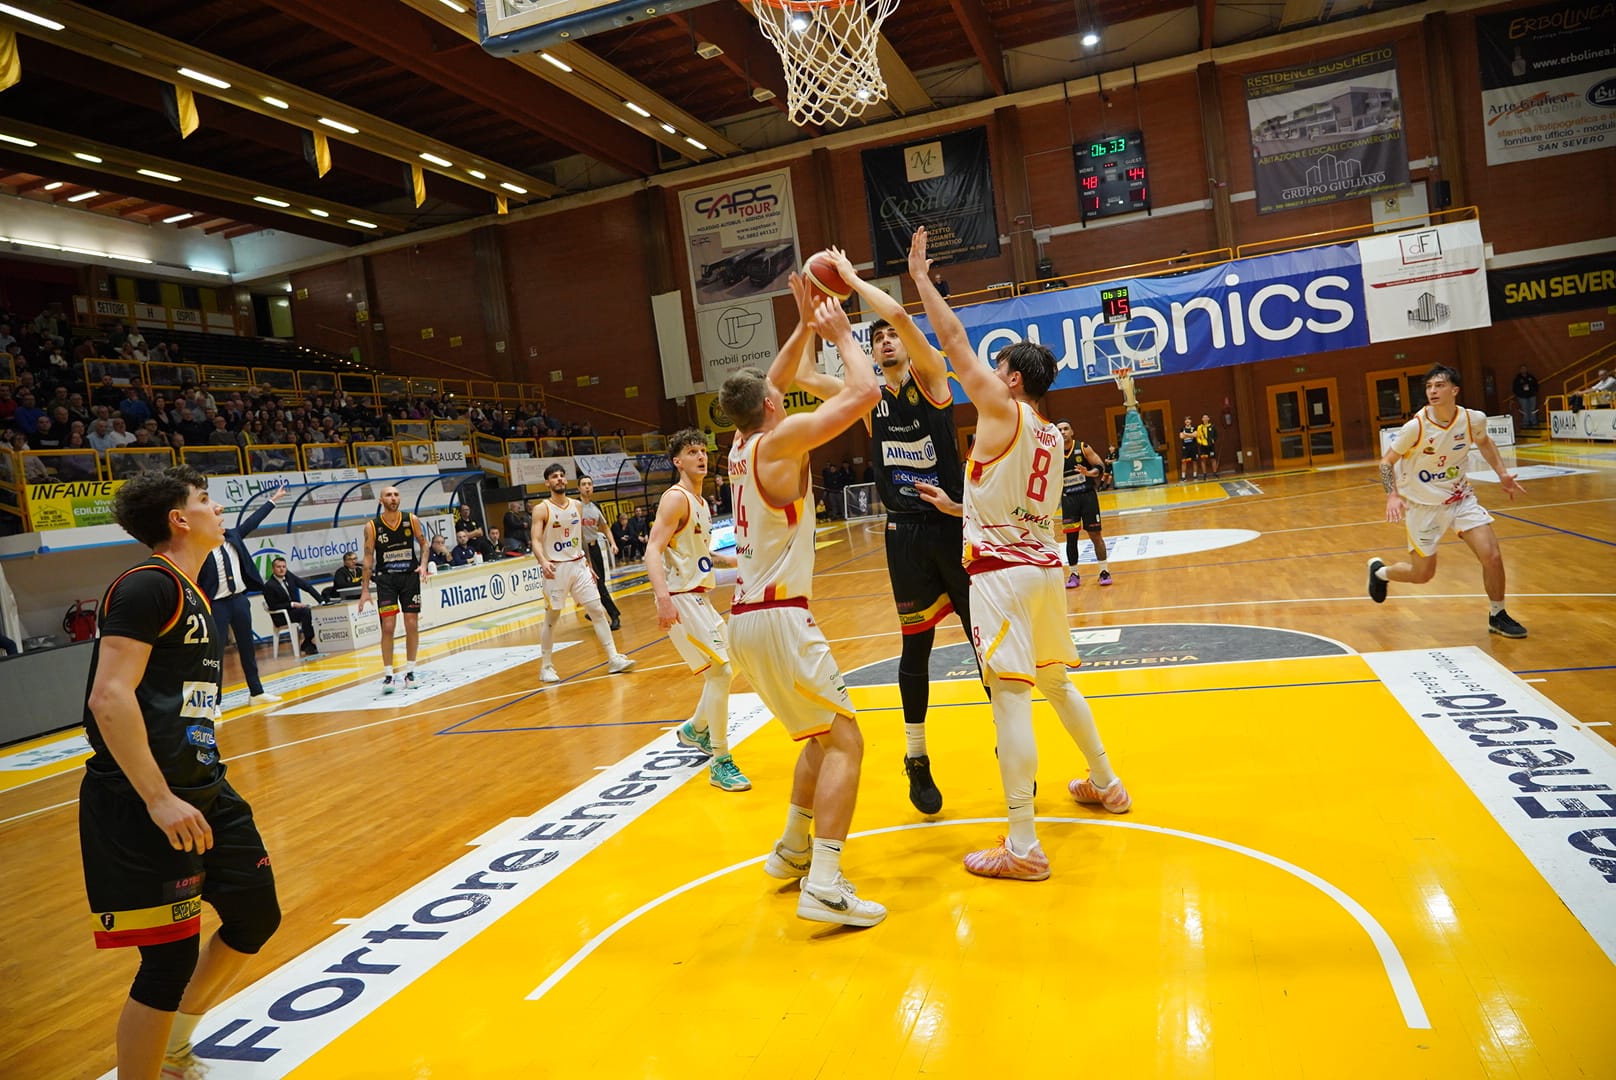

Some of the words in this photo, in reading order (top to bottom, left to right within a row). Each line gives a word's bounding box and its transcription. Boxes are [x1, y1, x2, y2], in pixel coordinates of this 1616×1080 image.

[1247, 68, 1316, 88] RESIDENCE
[1319, 48, 1393, 73] BUSCHETTO
[1488, 101, 1518, 115] Arte
[1504, 134, 1543, 147] forniture
[1545, 128, 1574, 141] ufficio
[1537, 141, 1559, 152] SAN
[1562, 135, 1606, 149] SEVERO
[1082, 175, 1098, 189] 48
[1129, 167, 1145, 181] 44
[1282, 183, 1328, 201] GRUPPO
[1329, 172, 1387, 193] GIULIANO
[738, 201, 771, 218] TOUR
[1504, 283, 1547, 305] SAN
[1549, 269, 1616, 299] SEVER
[97, 301, 126, 316] SETTORE
[1109, 298, 1129, 316] 15
[709, 353, 739, 368] mobili
[742, 350, 771, 364] priore
[875, 402, 890, 418] 10
[886, 446, 925, 461] Allianz
[1437, 455, 1447, 467] 3
[1026, 447, 1052, 502] 8
[31, 481, 113, 501] INFANTE
[73, 506, 112, 516] EDILIZIA
[378, 532, 389, 544] 45
[291, 538, 359, 562] Autorekord
[440, 582, 488, 609] Allianz
[184, 613, 209, 644] 21
[972, 625, 981, 647] 8
[191, 847, 562, 1063] Fortore
